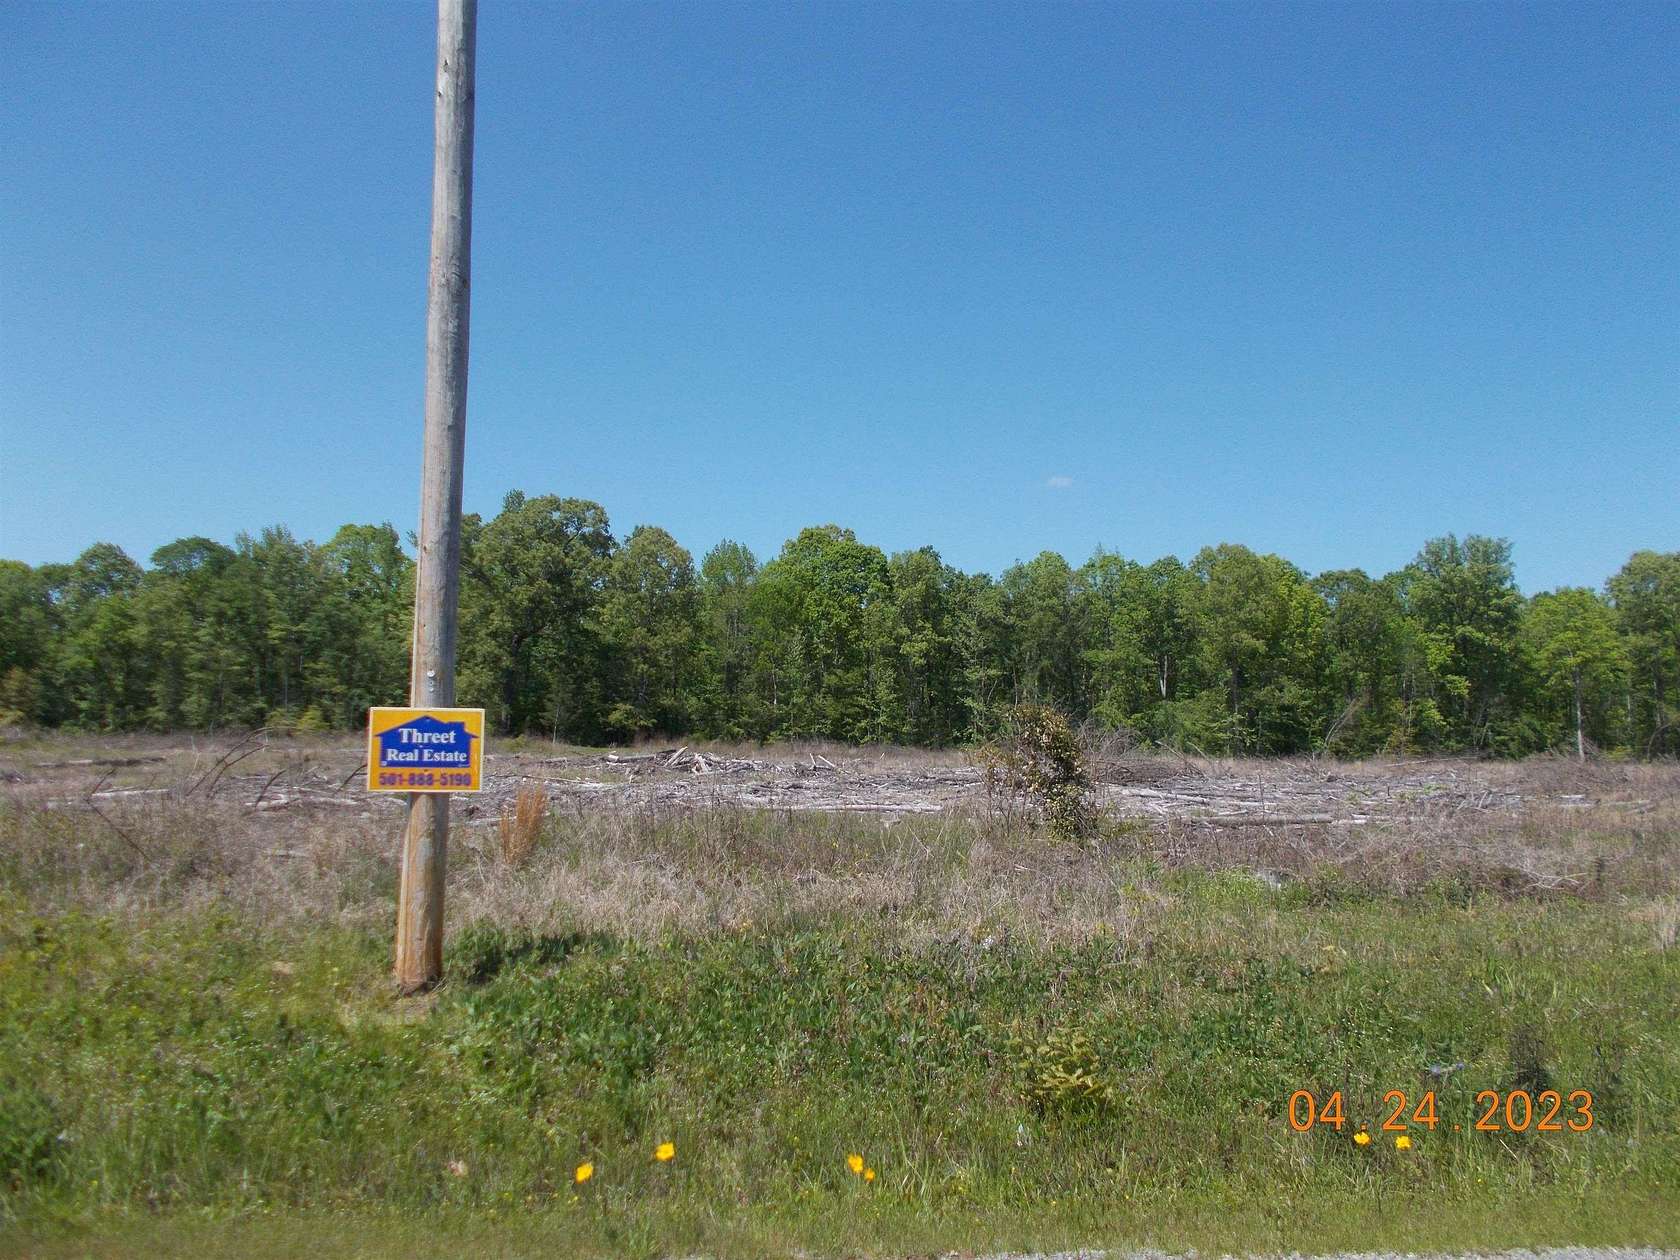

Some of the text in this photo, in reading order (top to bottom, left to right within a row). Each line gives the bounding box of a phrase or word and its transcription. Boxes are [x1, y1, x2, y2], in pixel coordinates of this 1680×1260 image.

[398, 728, 456, 744] Threet
[386, 748, 468, 762] Real Estate
